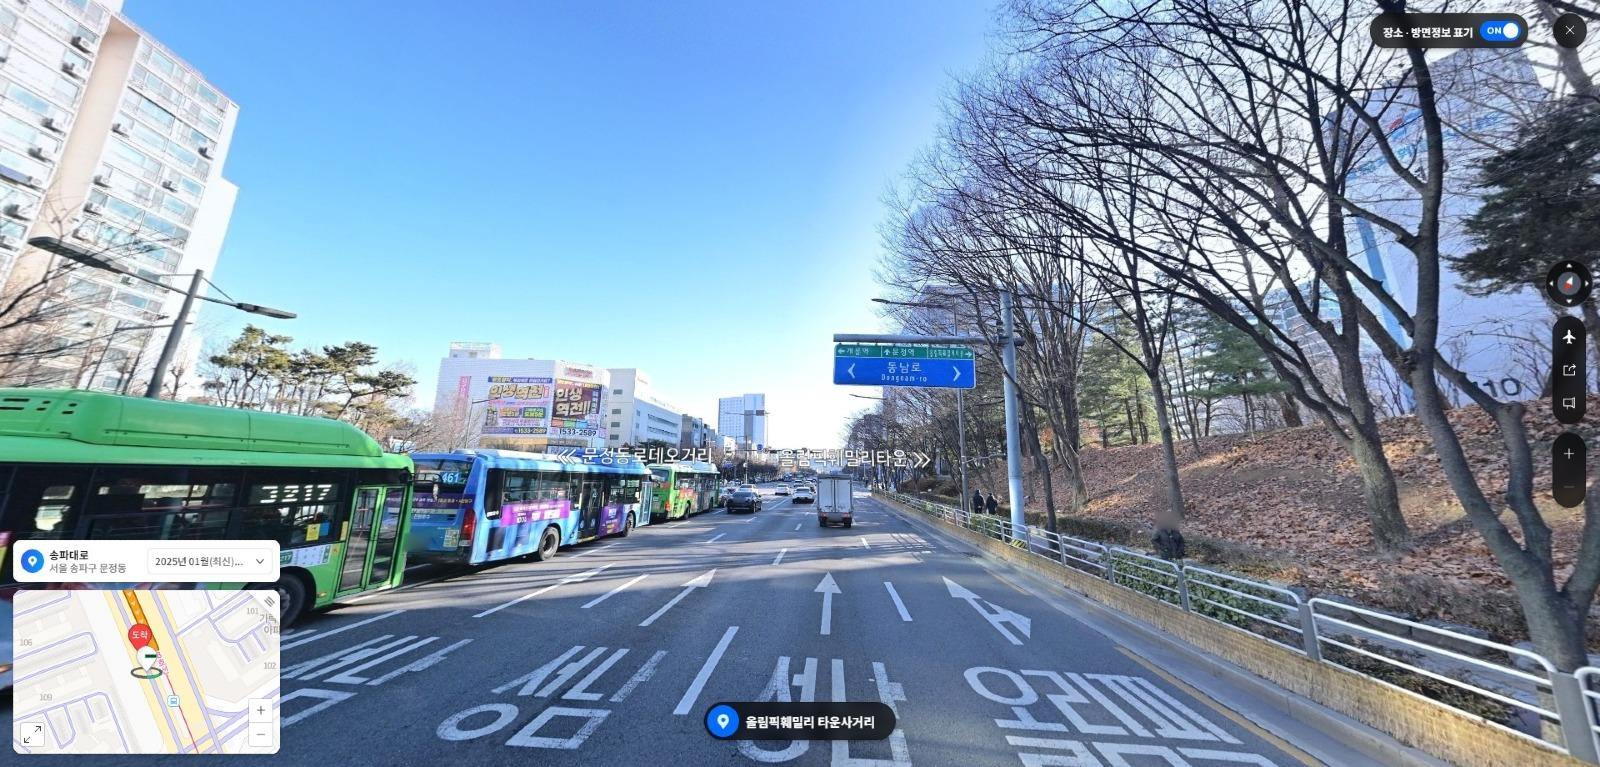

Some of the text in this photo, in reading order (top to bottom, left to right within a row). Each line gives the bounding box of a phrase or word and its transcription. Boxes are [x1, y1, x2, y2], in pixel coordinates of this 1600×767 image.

[891, 348, 915, 357] 문정역
[887, 361, 922, 374] 동남로
[555, 387, 583, 402] 인생
[559, 428, 597, 437] 1533-2589
[442, 472, 460, 483] 461
[259, 484, 332, 504] 3217
[436, 645, 668, 750] 성남
